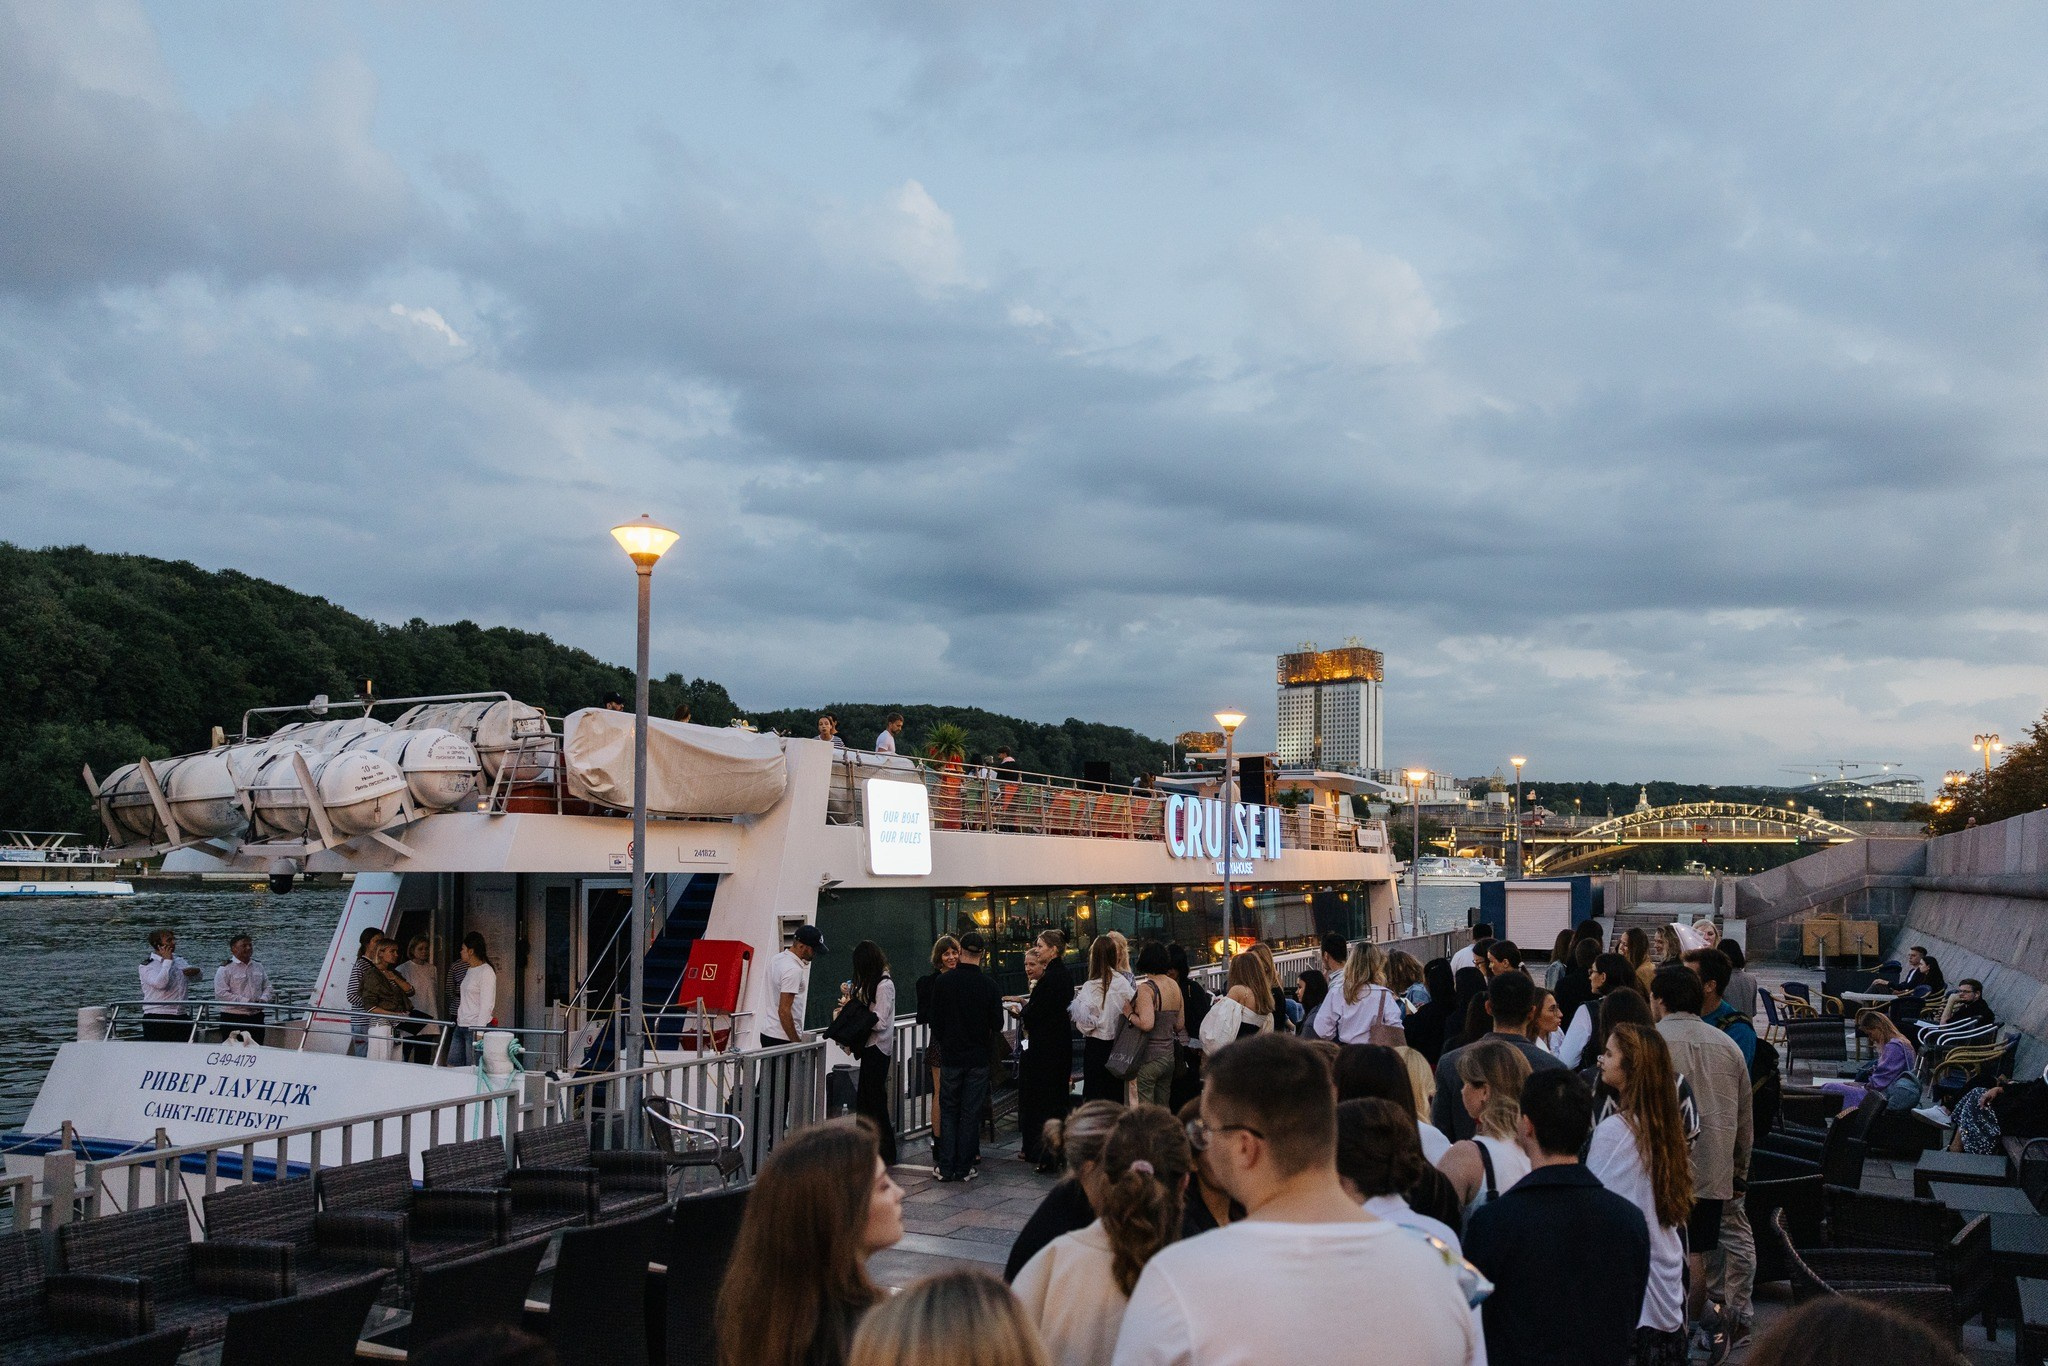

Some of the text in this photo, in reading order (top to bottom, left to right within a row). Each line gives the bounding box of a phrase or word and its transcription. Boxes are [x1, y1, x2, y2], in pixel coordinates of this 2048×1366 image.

[883, 810, 920, 824] OUR BOAT
[880, 830, 922, 845] OUR RULES
[694, 849, 717, 857] 241822
[139, 1070, 317, 1109] РИВЕР ЛАУНДЖ
[144, 1100, 289, 1130] САНКТ-ПЕТЕРБУРГ
